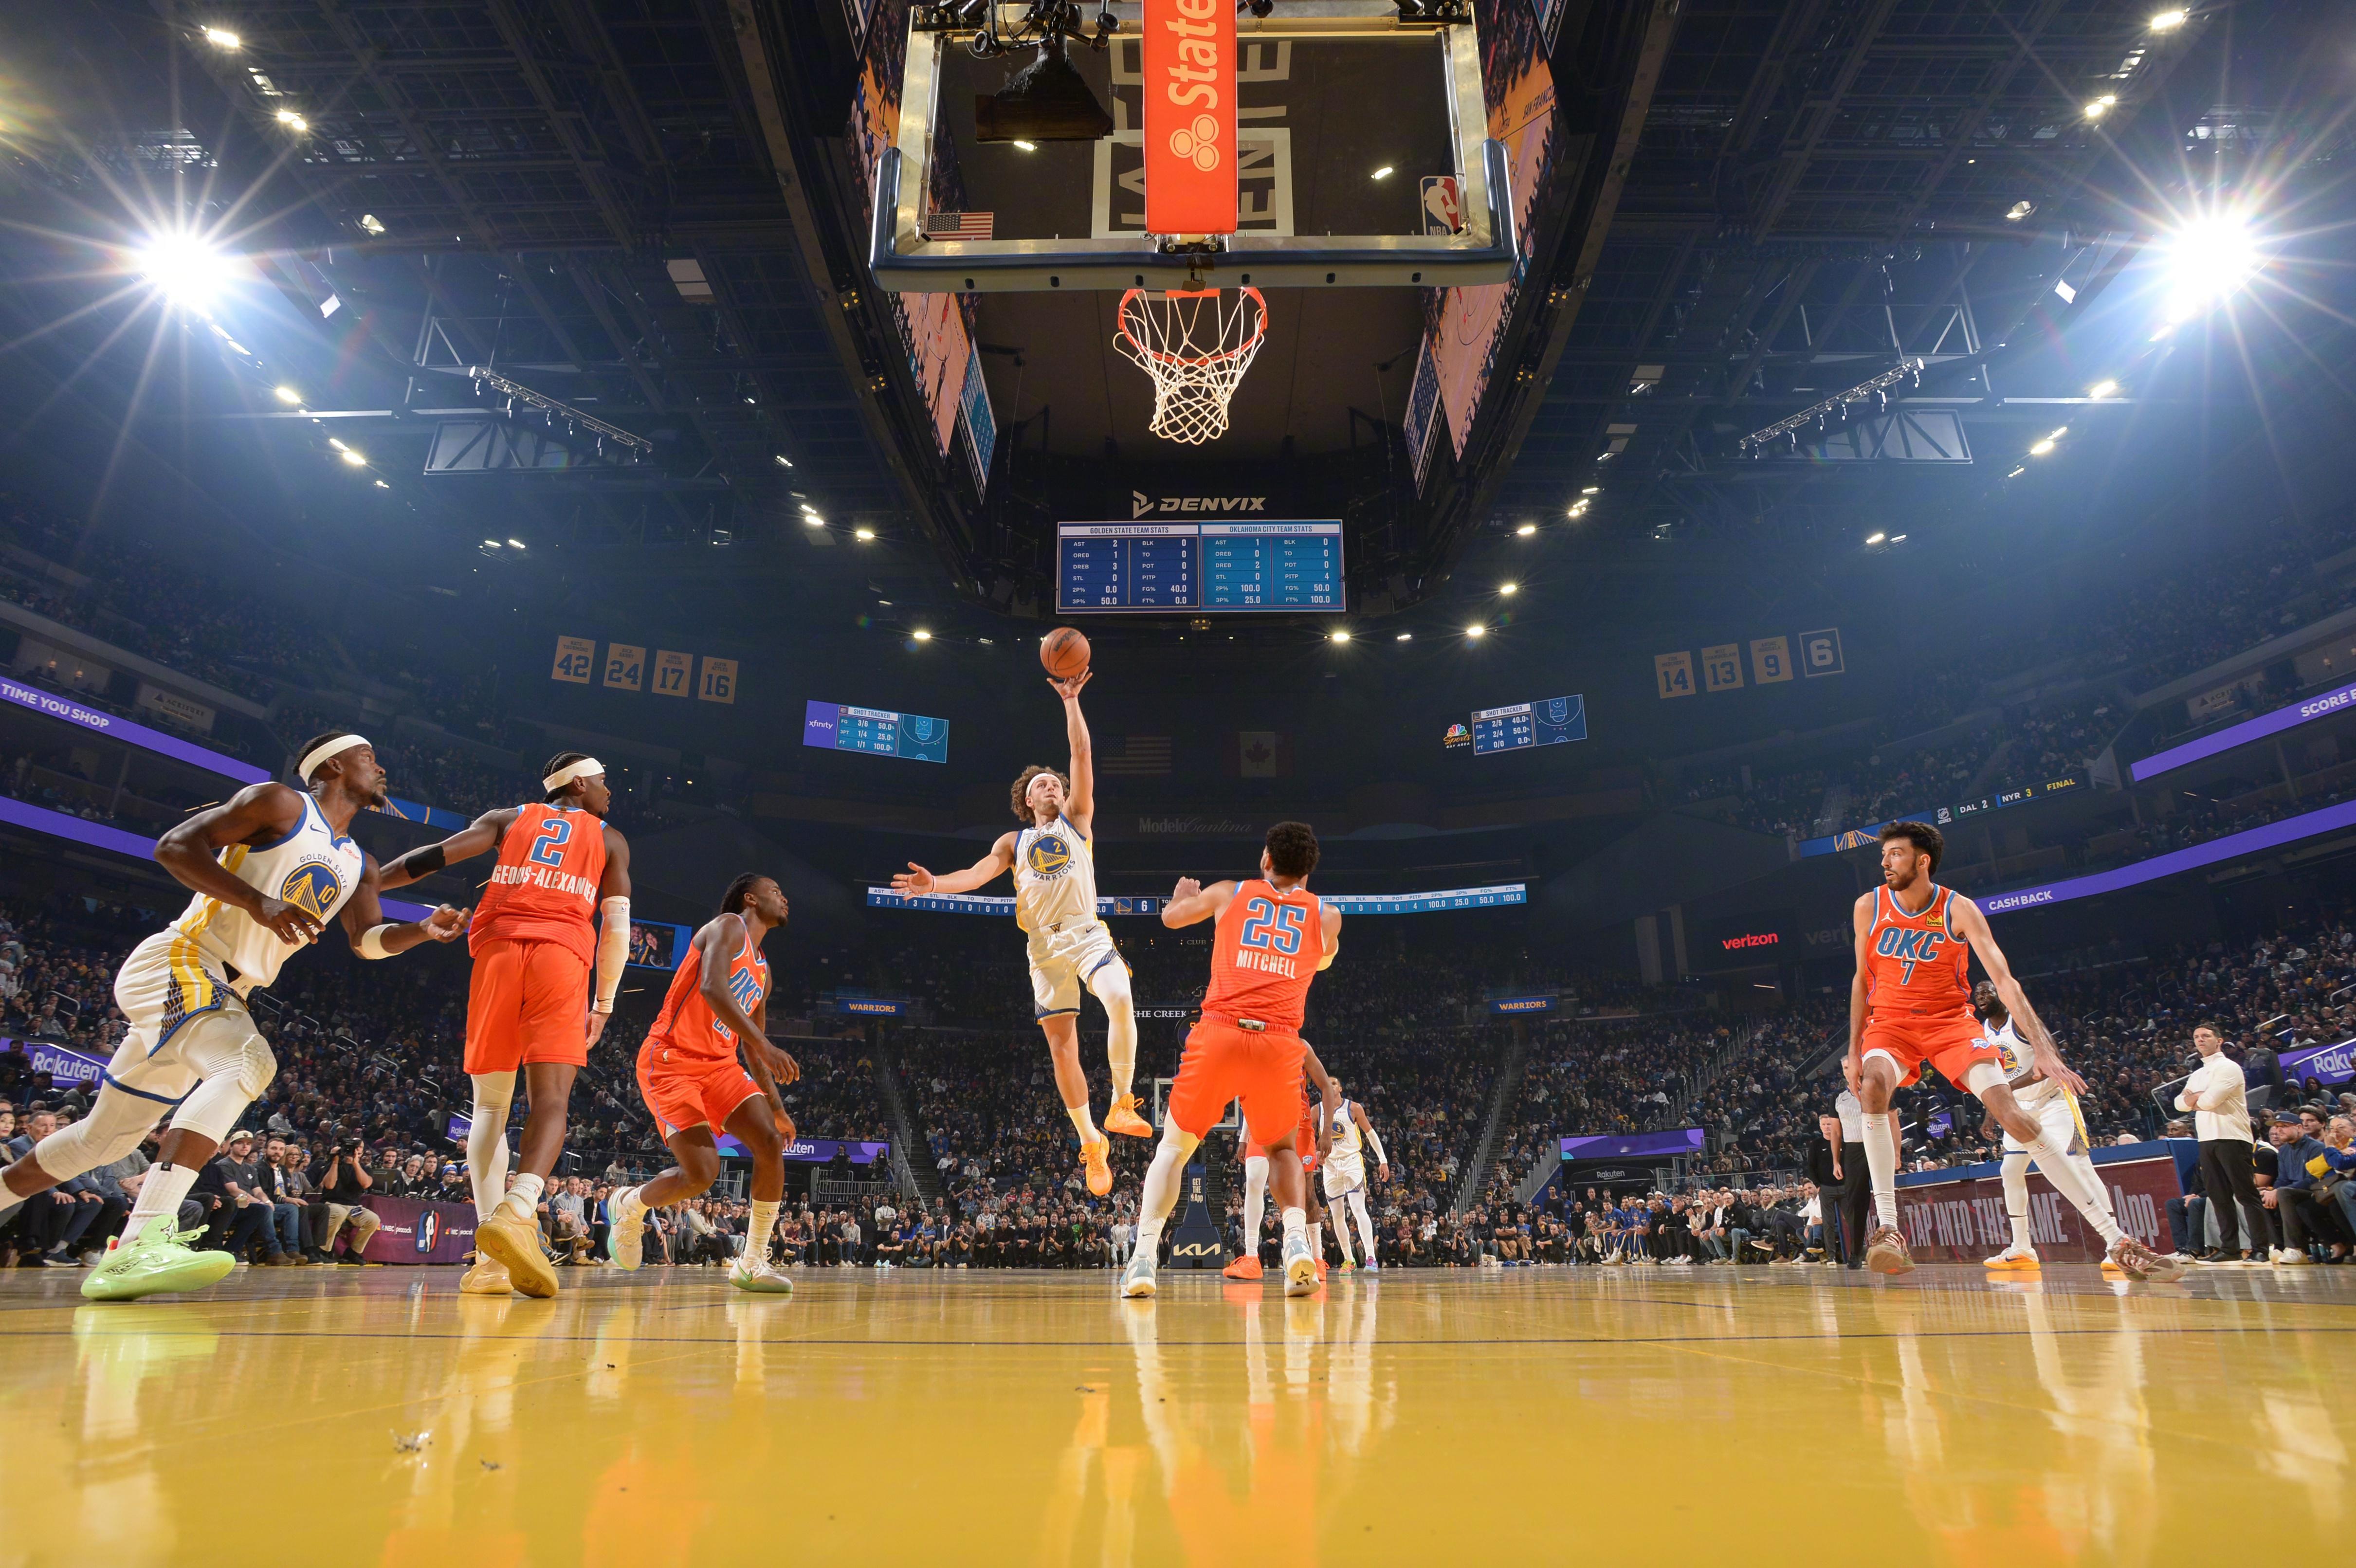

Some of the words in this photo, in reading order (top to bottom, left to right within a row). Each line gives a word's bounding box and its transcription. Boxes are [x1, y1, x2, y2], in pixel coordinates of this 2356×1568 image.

[1165, 0, 1218, 109] State
[1430, 226, 1447, 236] NBA
[1159, 497, 1266, 511] DENVIX
[1809, 638, 1833, 666] 6
[557, 654, 589, 678] 42
[608, 660, 640, 685] 24
[1710, 661, 1736, 685] 13
[1764, 655, 1780, 676] 9
[659, 667, 684, 691] 17
[705, 674, 730, 697] 16
[1663, 668, 1689, 692] 14
[1, 684, 38, 705] TIME
[40, 697, 70, 715] YOU
[71, 709, 109, 728] SHOP
[868, 711, 890, 719] TRACKER
[1500, 706, 1522, 715] TRACKER
[2301, 693, 2349, 717] SCORE
[809, 720, 833, 729] xfinity
[1443, 734, 1472, 745] Sports
[1960, 804, 1977, 813] DAL
[1982, 800, 1988, 809] 2
[2002, 792, 2021, 802] NYR
[2026, 788, 2032, 797] 3
[2046, 779, 2076, 791] FINAL
[1139, 817, 1187, 833] Modelo
[1185, 817, 1253, 833] Cantina
[529, 818, 572, 868] 2
[1053, 841, 1062, 853] 2
[299, 853, 332, 865] GOLDEN
[334, 864, 347, 890] STATE
[1033, 860, 1075, 881] WARRIORS
[318, 884, 335, 903] 10
[1428, 899, 1445, 908] 100.0
[1455, 898, 1469, 906] 25.0
[1479, 895, 1494, 904] 50.0
[1503, 893, 1521, 902] 100.0
[1989, 898, 2020, 911] CASH
[2021, 891, 2053, 905] BACK
[1141, 900, 1148, 912] 6
[1240, 896, 1307, 954] 25
[1722, 932, 1778, 950] verizon
[1876, 927, 1945, 962] OKC
[1236, 950, 1296, 979] MITCHELL
[1900, 960, 1916, 985] 7
[728, 966, 763, 1016] OKC
[848, 1003, 896, 1013] WARRIORS
[1499, 1001, 1547, 1010] WARRIORS
[2003, 1050, 2012, 1059] 23
[2313, 1051, 2356, 1074] Raku
[32, 1052, 101, 1079] Rakuten
[451, 1127, 470, 1135] Rakut
[783, 1143, 814, 1154] kuten
[1597, 1170, 1625, 1178] Rakuten
[1194, 1194, 1203, 1203] App
[1905, 1205, 1932, 1247] TAP
[1934, 1200, 1973, 1246] INTO
[1972, 1197, 2010, 1245] THE
[2027, 1192, 2068, 1243] AME
[2114, 1185, 2160, 1247] App
[1173, 1243, 1221, 1256] KIA
